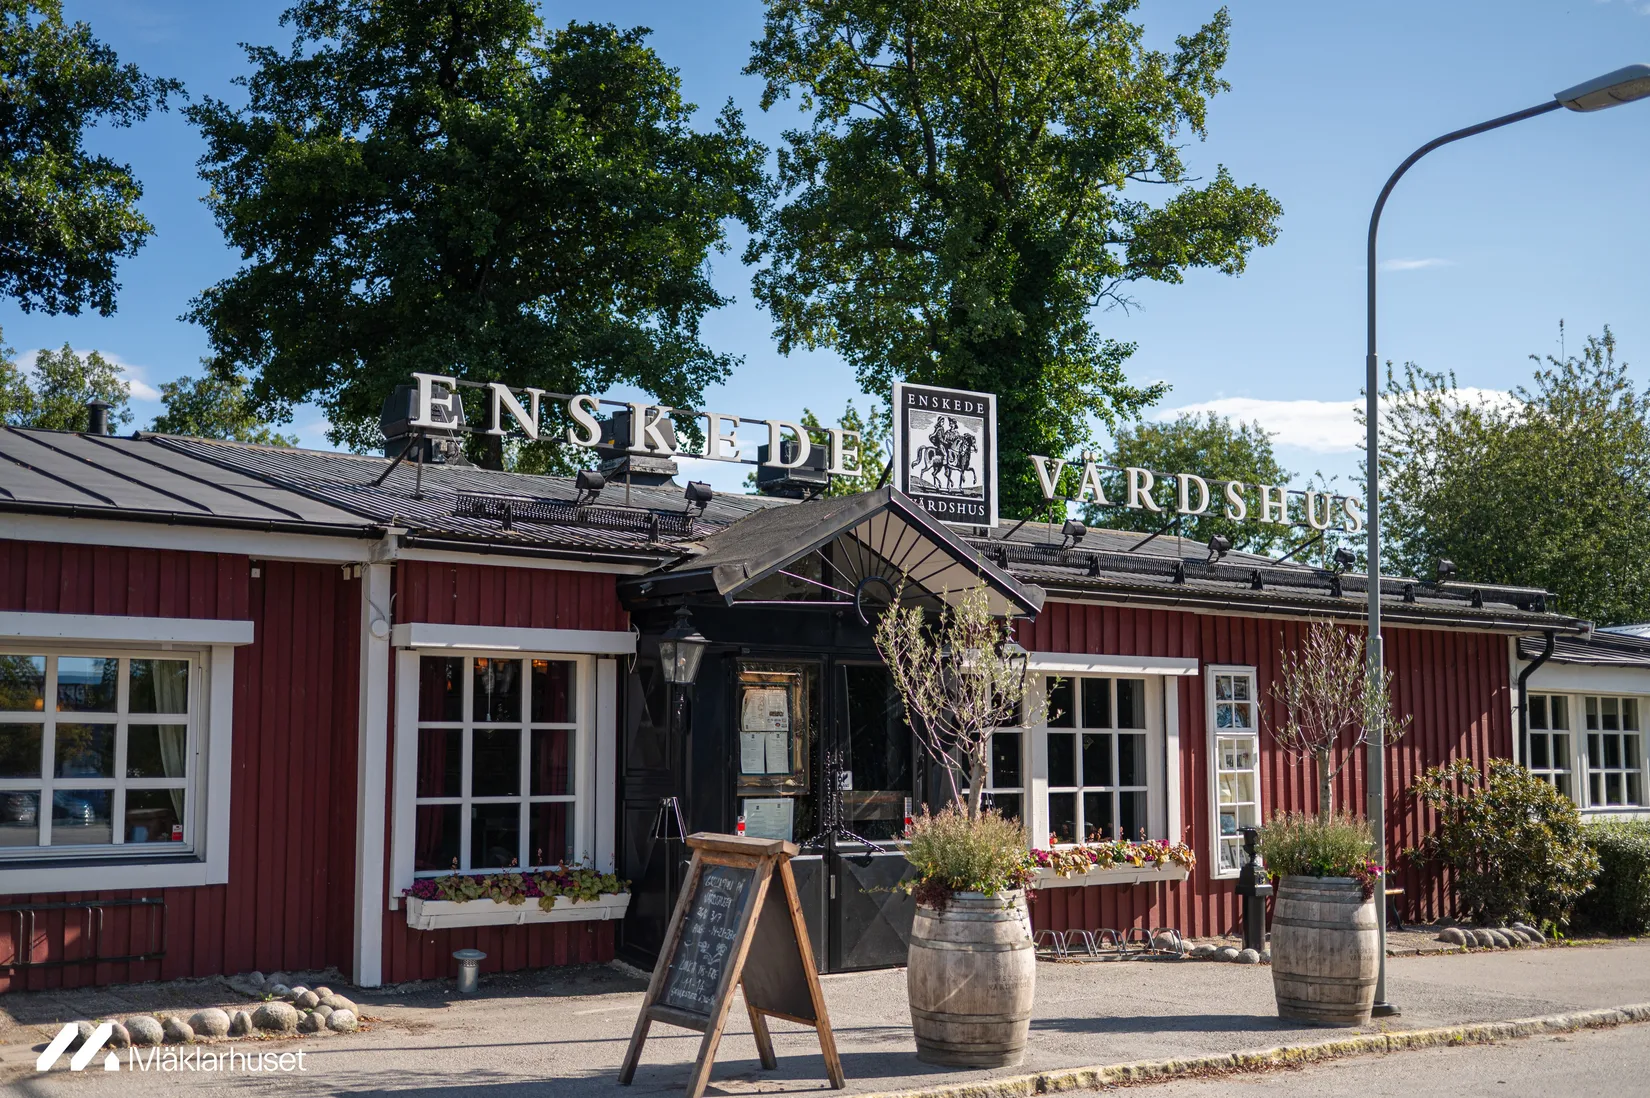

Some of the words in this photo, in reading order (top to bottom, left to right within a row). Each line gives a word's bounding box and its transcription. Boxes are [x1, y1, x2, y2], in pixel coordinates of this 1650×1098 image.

[907, 393, 985, 414] ENSKEDE
[410, 372, 863, 477] ENSKEDE
[1027, 450, 1363, 533] VÄRDSHUS
[909, 498, 985, 516] ÄRDSHUS
